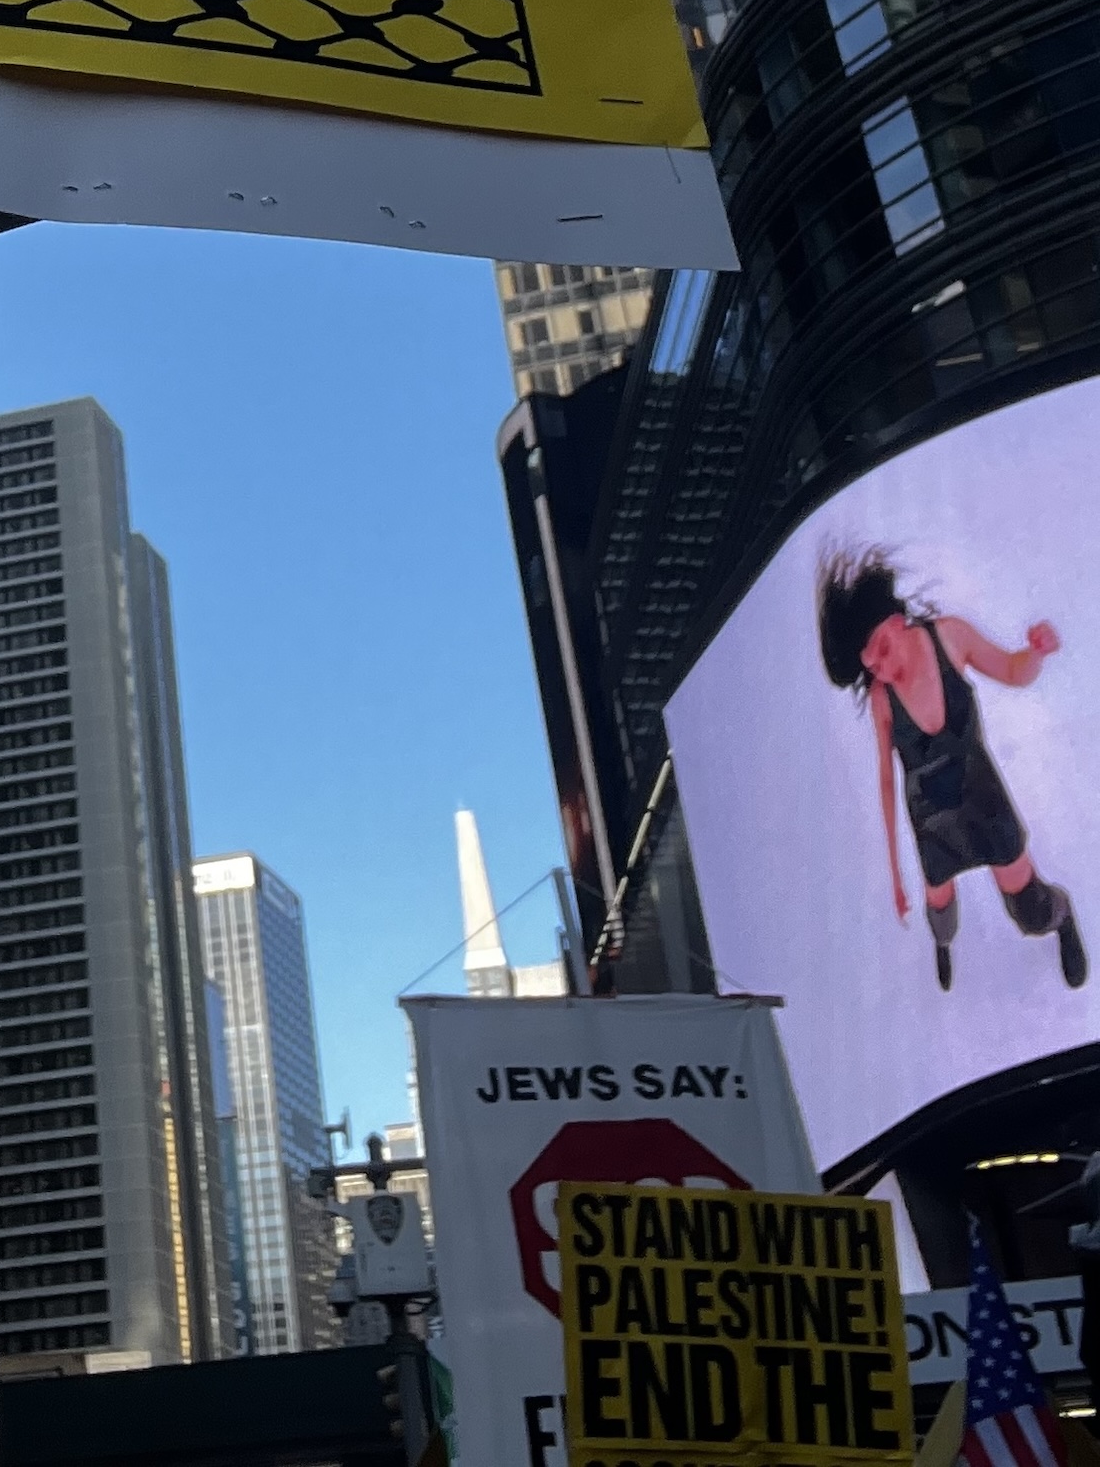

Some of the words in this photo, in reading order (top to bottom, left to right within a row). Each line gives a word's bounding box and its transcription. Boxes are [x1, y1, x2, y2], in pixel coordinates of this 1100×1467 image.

[477, 1064, 620, 1103] JEWS
[632, 1064, 748, 1101] SAY:
[573, 1193, 740, 1262] STAND
[751, 1202, 883, 1271] WITH
[577, 1264, 889, 1347] PALESTINE!
[581, 1339, 741, 1442] END
[756, 1345, 900, 1449] THE
